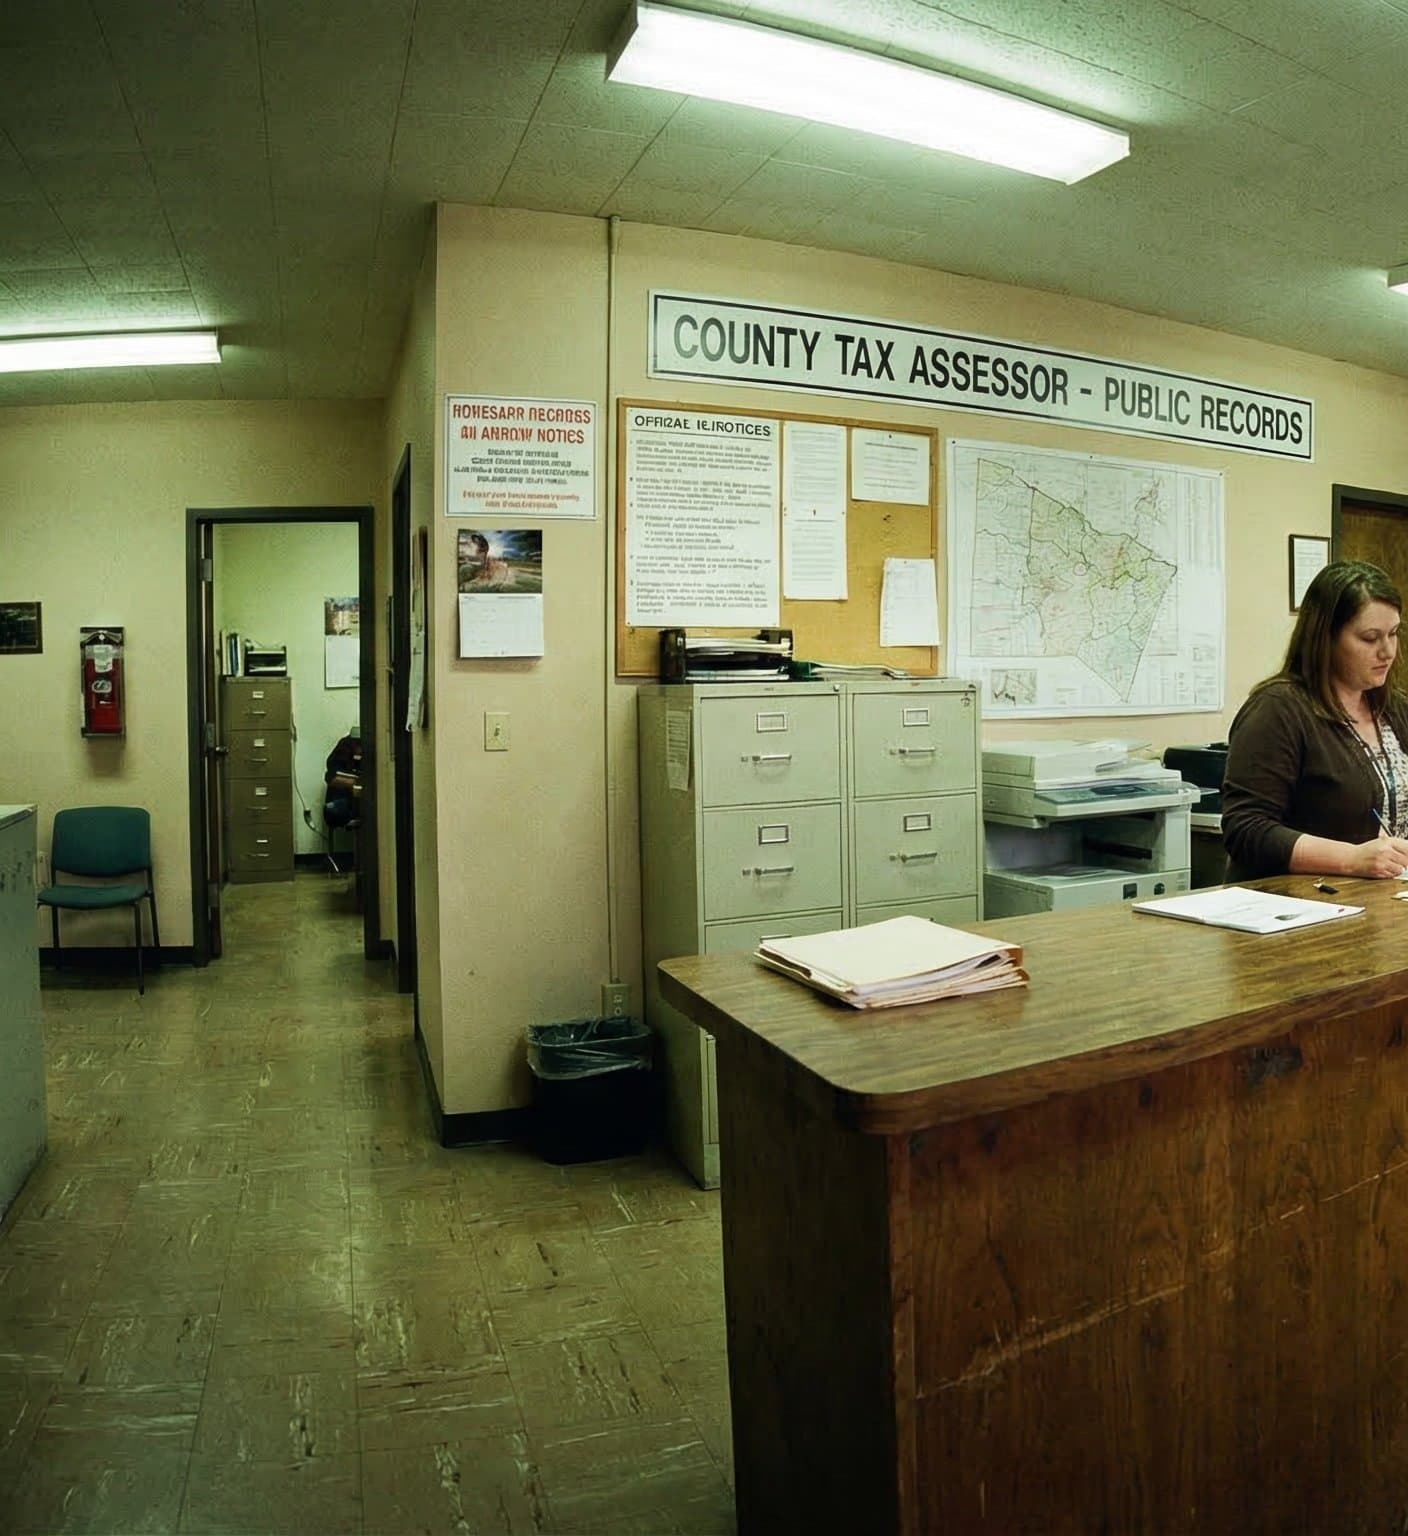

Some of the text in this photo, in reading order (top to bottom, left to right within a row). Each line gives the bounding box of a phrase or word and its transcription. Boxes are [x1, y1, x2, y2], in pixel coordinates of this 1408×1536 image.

[673, 314, 821, 371] COUNTY
[834, 333, 895, 381] TAX
[909, 345, 1068, 405] ASSESSOR
[1104, 376, 1191, 425] PUBLIC
[1200, 395, 1303, 445] RECORDS
